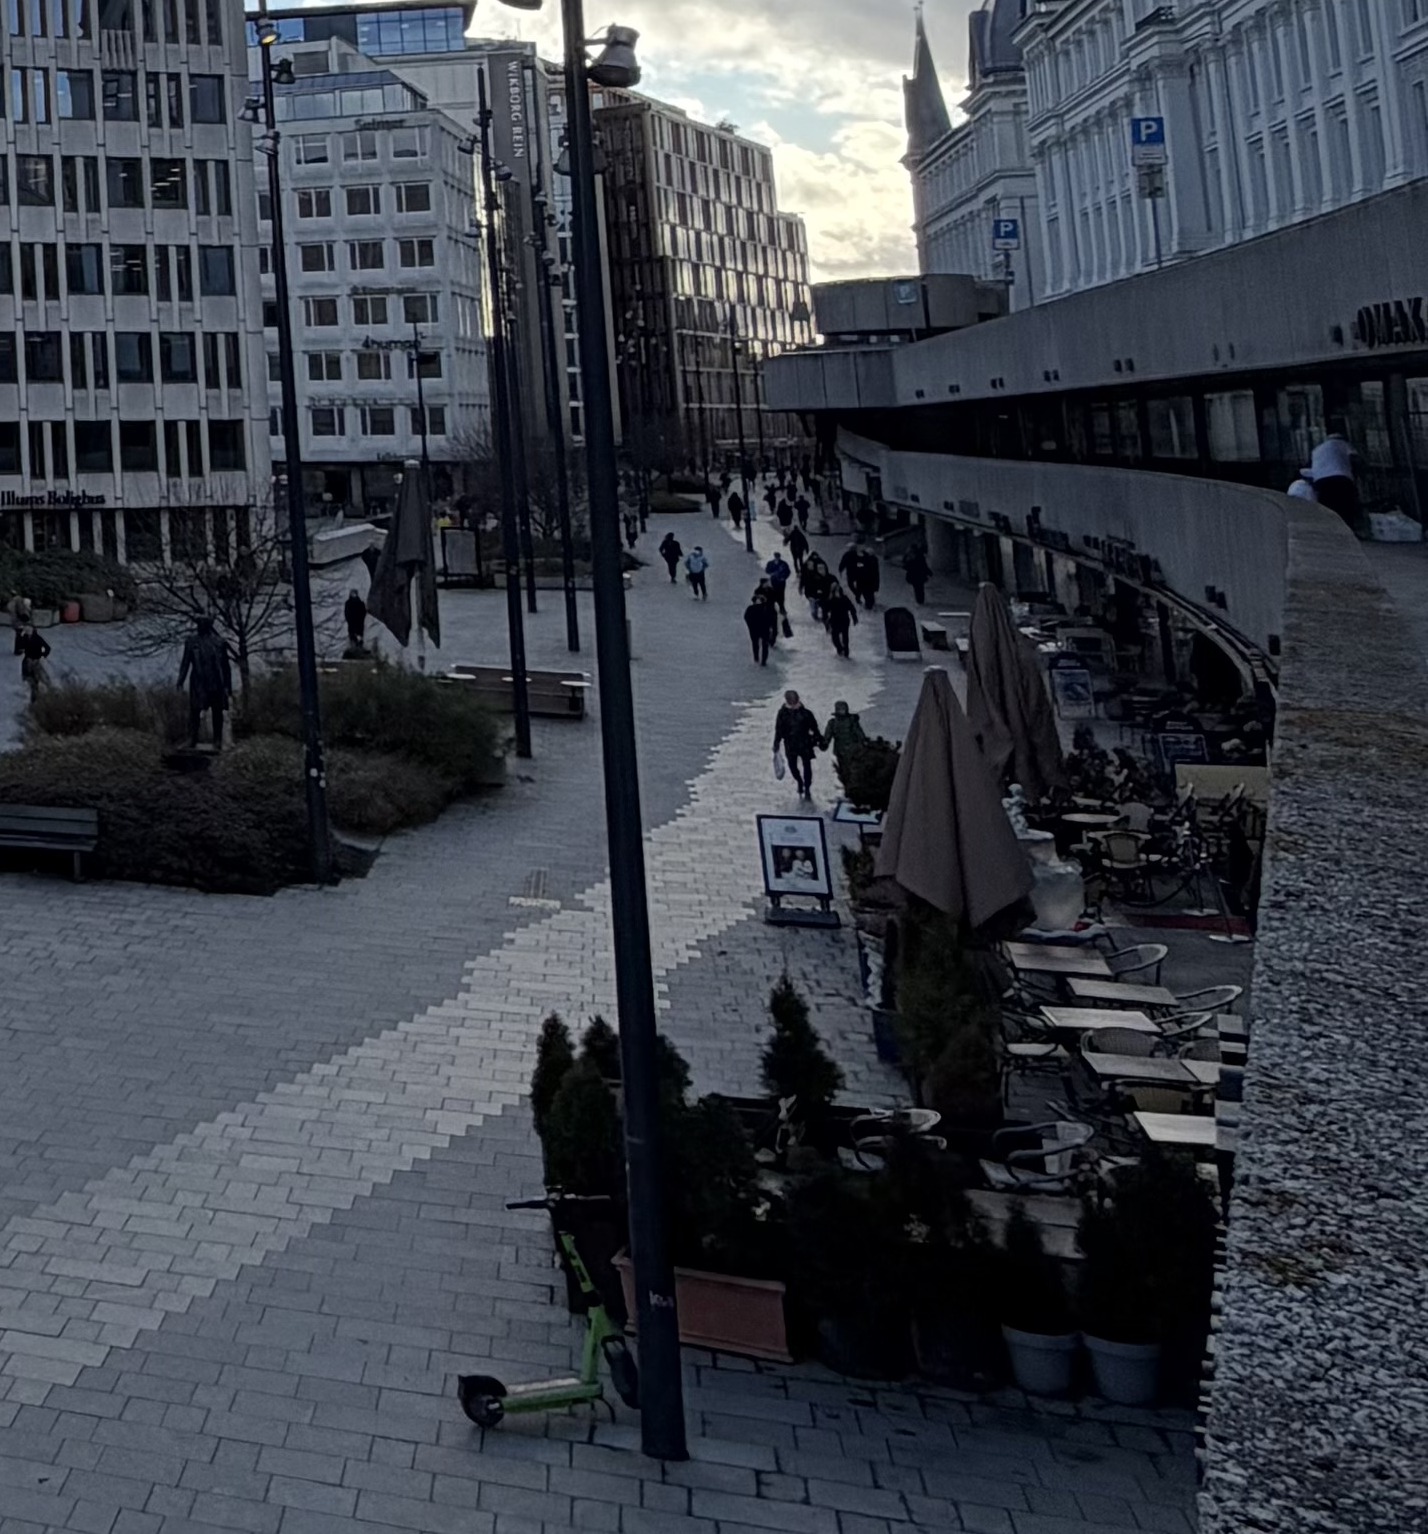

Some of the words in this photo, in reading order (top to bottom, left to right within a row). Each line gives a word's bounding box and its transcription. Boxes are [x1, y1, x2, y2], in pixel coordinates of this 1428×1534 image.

[507, 60, 523, 122] WIKBORG
[1140, 120, 1158, 142] P
[1000, 221, 1014, 237] P
[1, 490, 45, 506] Illums
